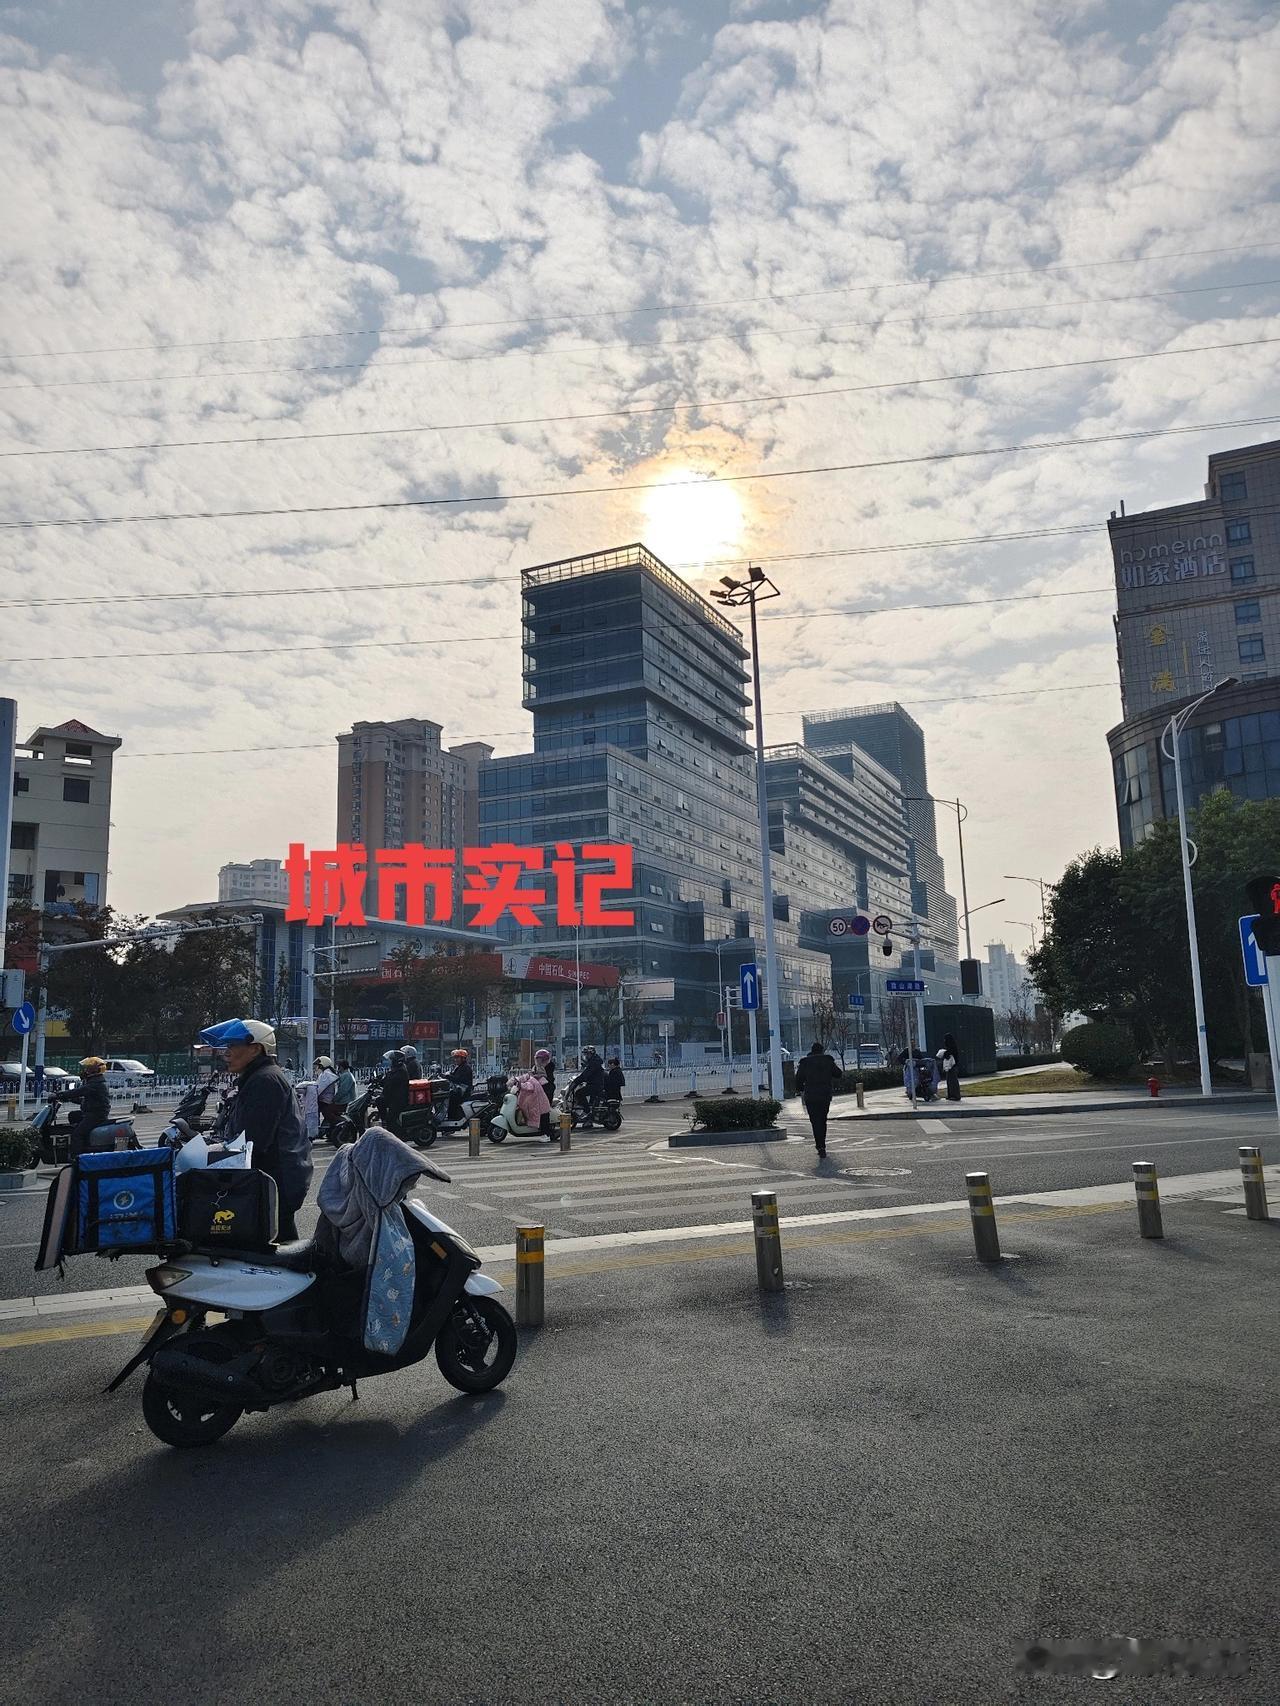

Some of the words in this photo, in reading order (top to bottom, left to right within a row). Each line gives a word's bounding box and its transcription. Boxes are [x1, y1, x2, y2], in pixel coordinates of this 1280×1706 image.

[1121, 551, 1226, 587] 如家酒店
[832, 922, 844, 932] 50
[538, 962, 564, 977] 中国石化
